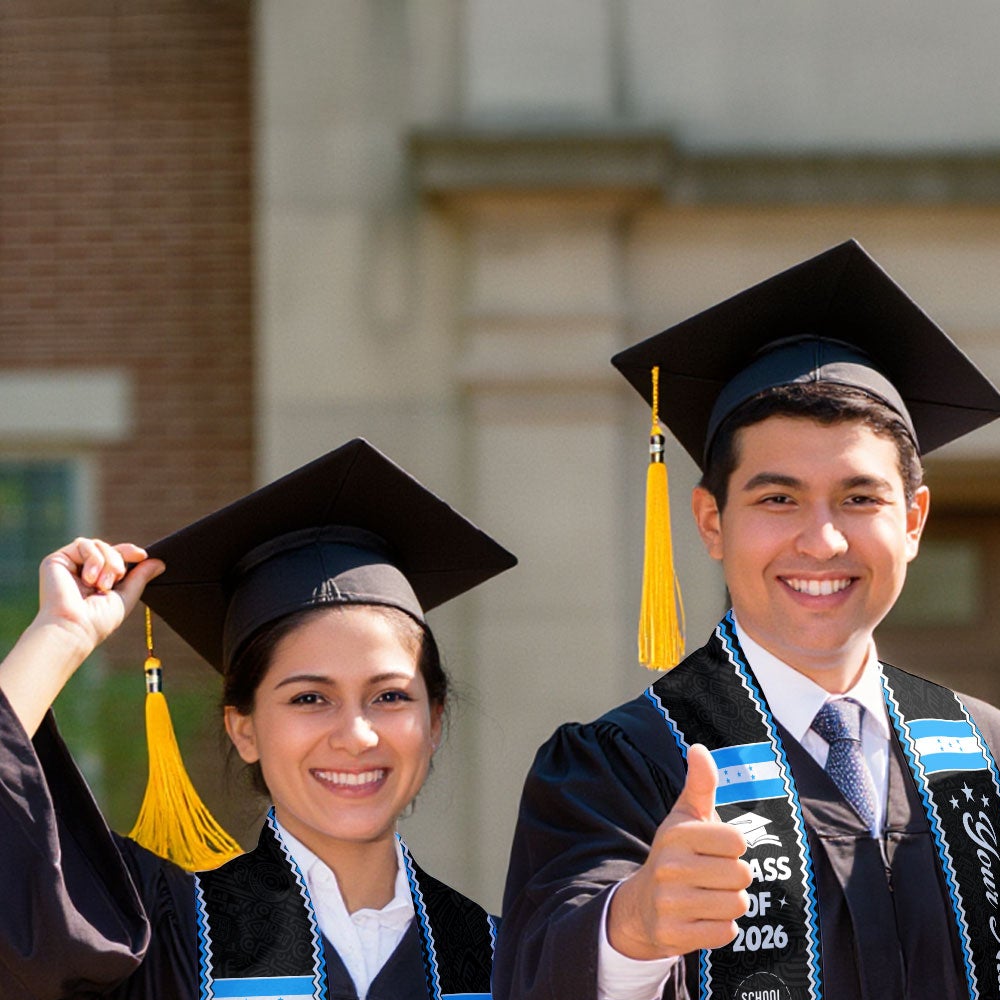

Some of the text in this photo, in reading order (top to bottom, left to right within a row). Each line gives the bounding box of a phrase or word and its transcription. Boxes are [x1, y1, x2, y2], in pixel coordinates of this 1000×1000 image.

[748, 856, 792, 882] ASS
[962, 810, 1000, 911] Your
[745, 891, 772, 918] OF
[732, 924, 789, 952] 2026
